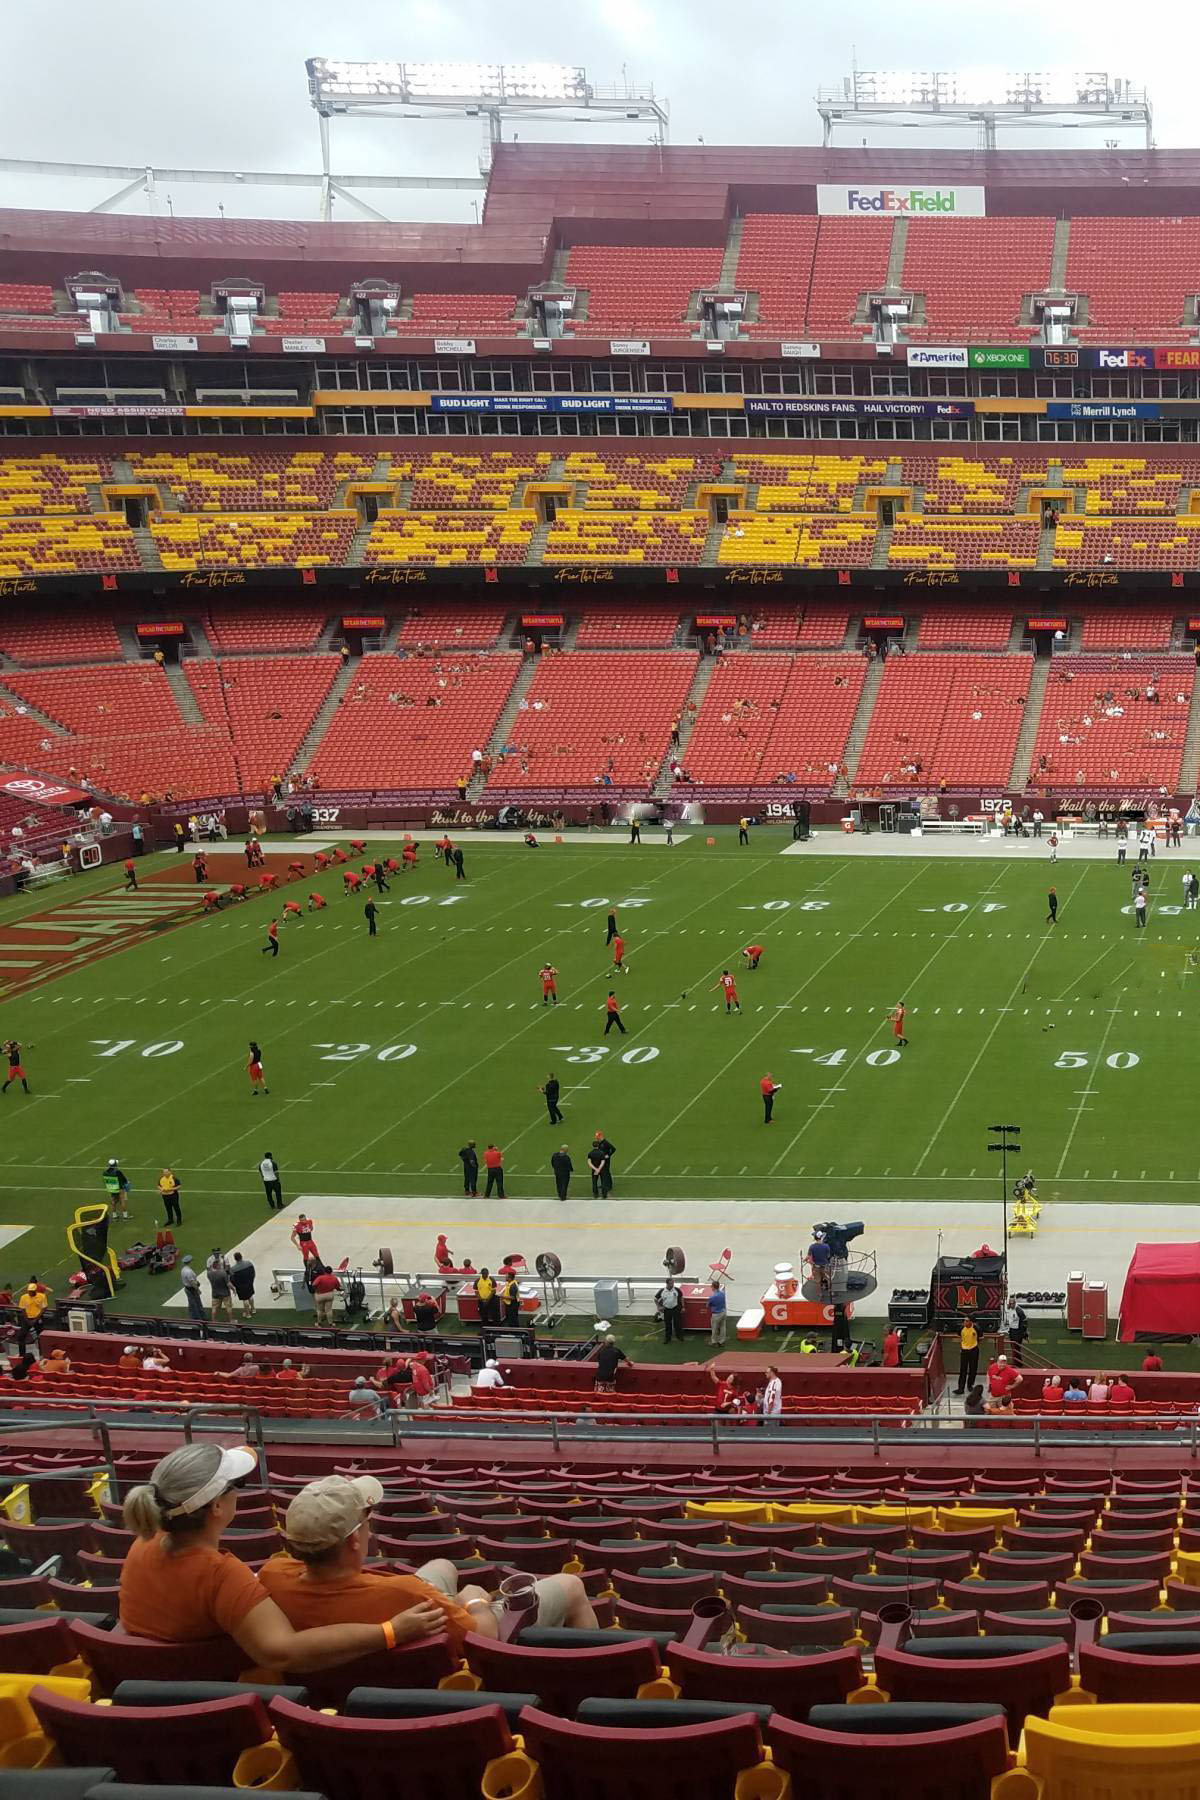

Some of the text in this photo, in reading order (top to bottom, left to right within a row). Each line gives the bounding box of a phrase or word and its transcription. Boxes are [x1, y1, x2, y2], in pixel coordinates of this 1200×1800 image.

[847, 190, 955, 212] FedExField
[1099, 350, 1146, 367] FedEx
[439, 399, 490, 407] BUD LIGHT
[561, 400, 611, 408] BUD LIGHT
[750, 402, 768, 410] HAIL
[785, 403, 829, 412] REDSKINS
[831, 404, 857, 412] FANS.
[864, 404, 884, 412] HAIL
[885, 405, 925, 413] VICTORY!
[937, 405, 960, 414] FedEx
[1083, 406, 1136, 417] Merrill Lynch
[766, 804, 797, 817] 194
[980, 799, 1012, 812] 1972
[1058, 799, 1086, 811] Hail
[1098, 799, 1115, 811] the
[96, 1040, 184, 1058] 10
[319, 1043, 418, 1061] 20
[566, 1046, 660, 1064] 30
[812, 1048, 902, 1066] 40
[1054, 1051, 1140, 1069] 50
[772, 1304, 788, 1320] G
